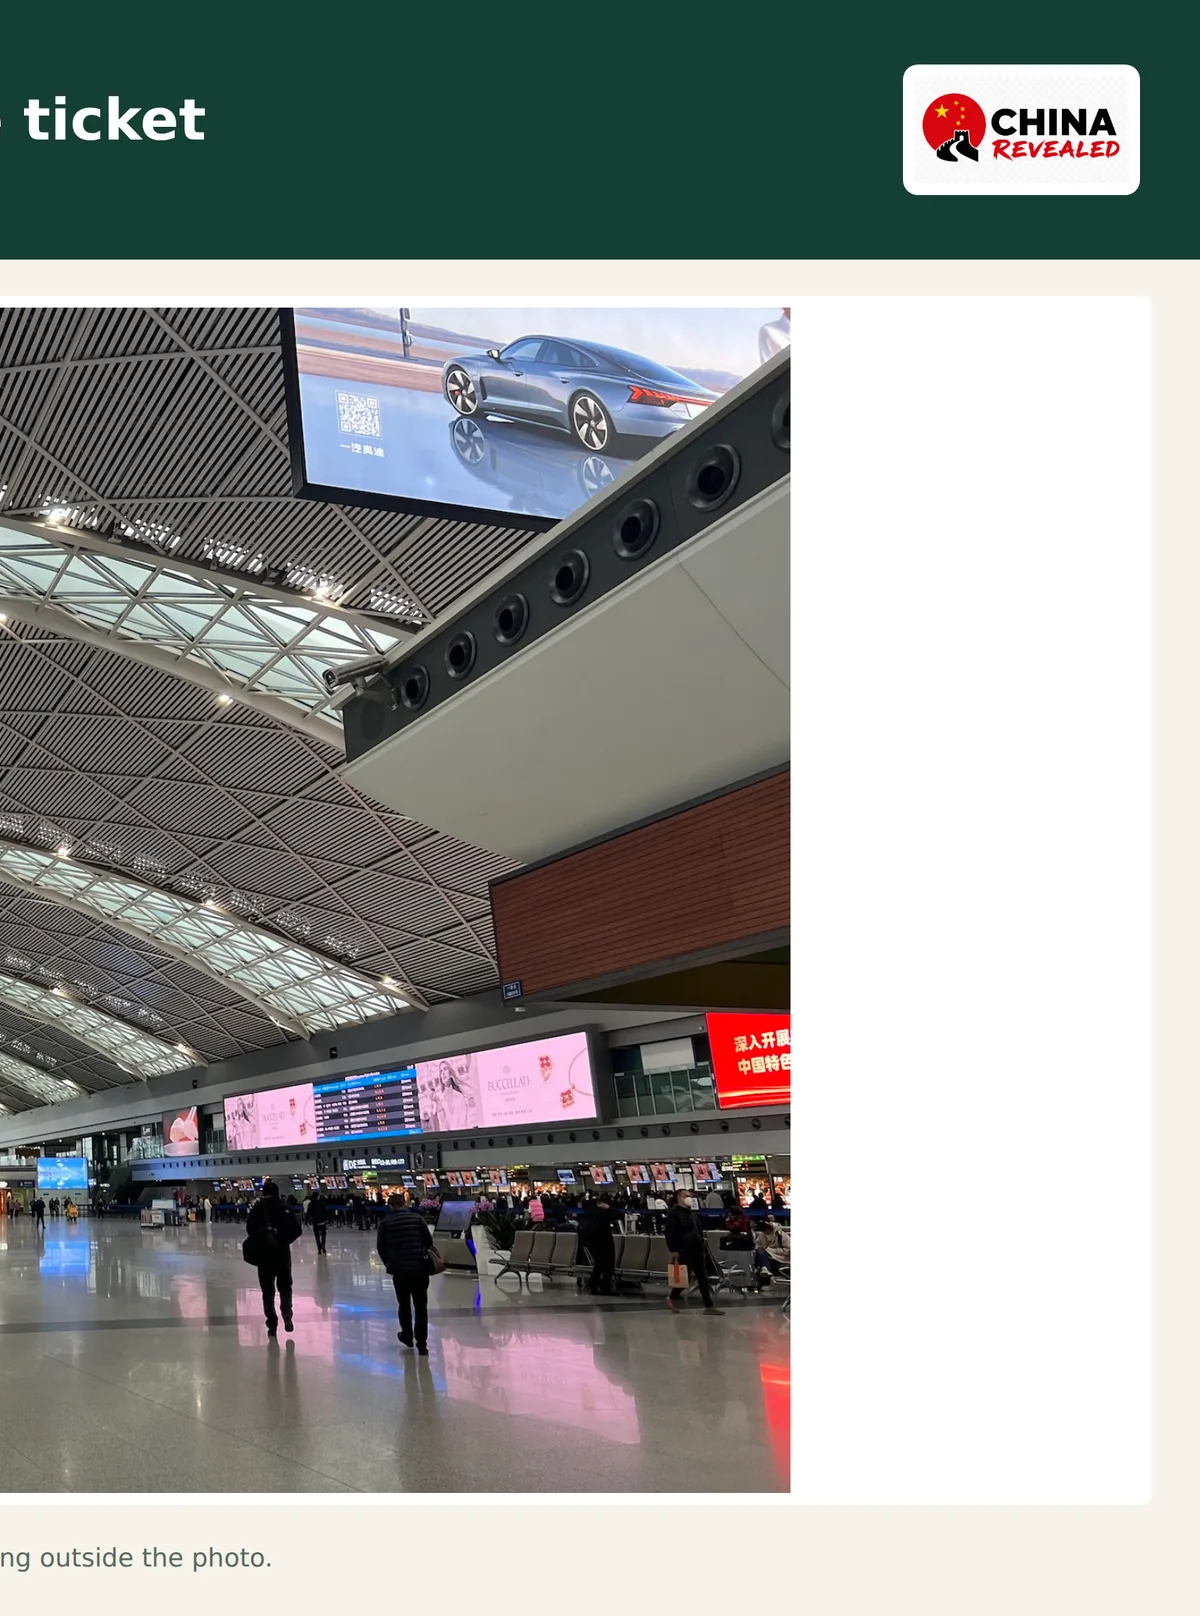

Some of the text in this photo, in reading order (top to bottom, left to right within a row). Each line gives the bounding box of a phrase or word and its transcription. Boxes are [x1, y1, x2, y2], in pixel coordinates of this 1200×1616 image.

[339, 442, 385, 457] 一汽奥迪
[733, 1028, 791, 1053] 深入开展
[738, 1053, 791, 1075] 中国特色
[487, 1075, 530, 1092] BUCCELLATI
